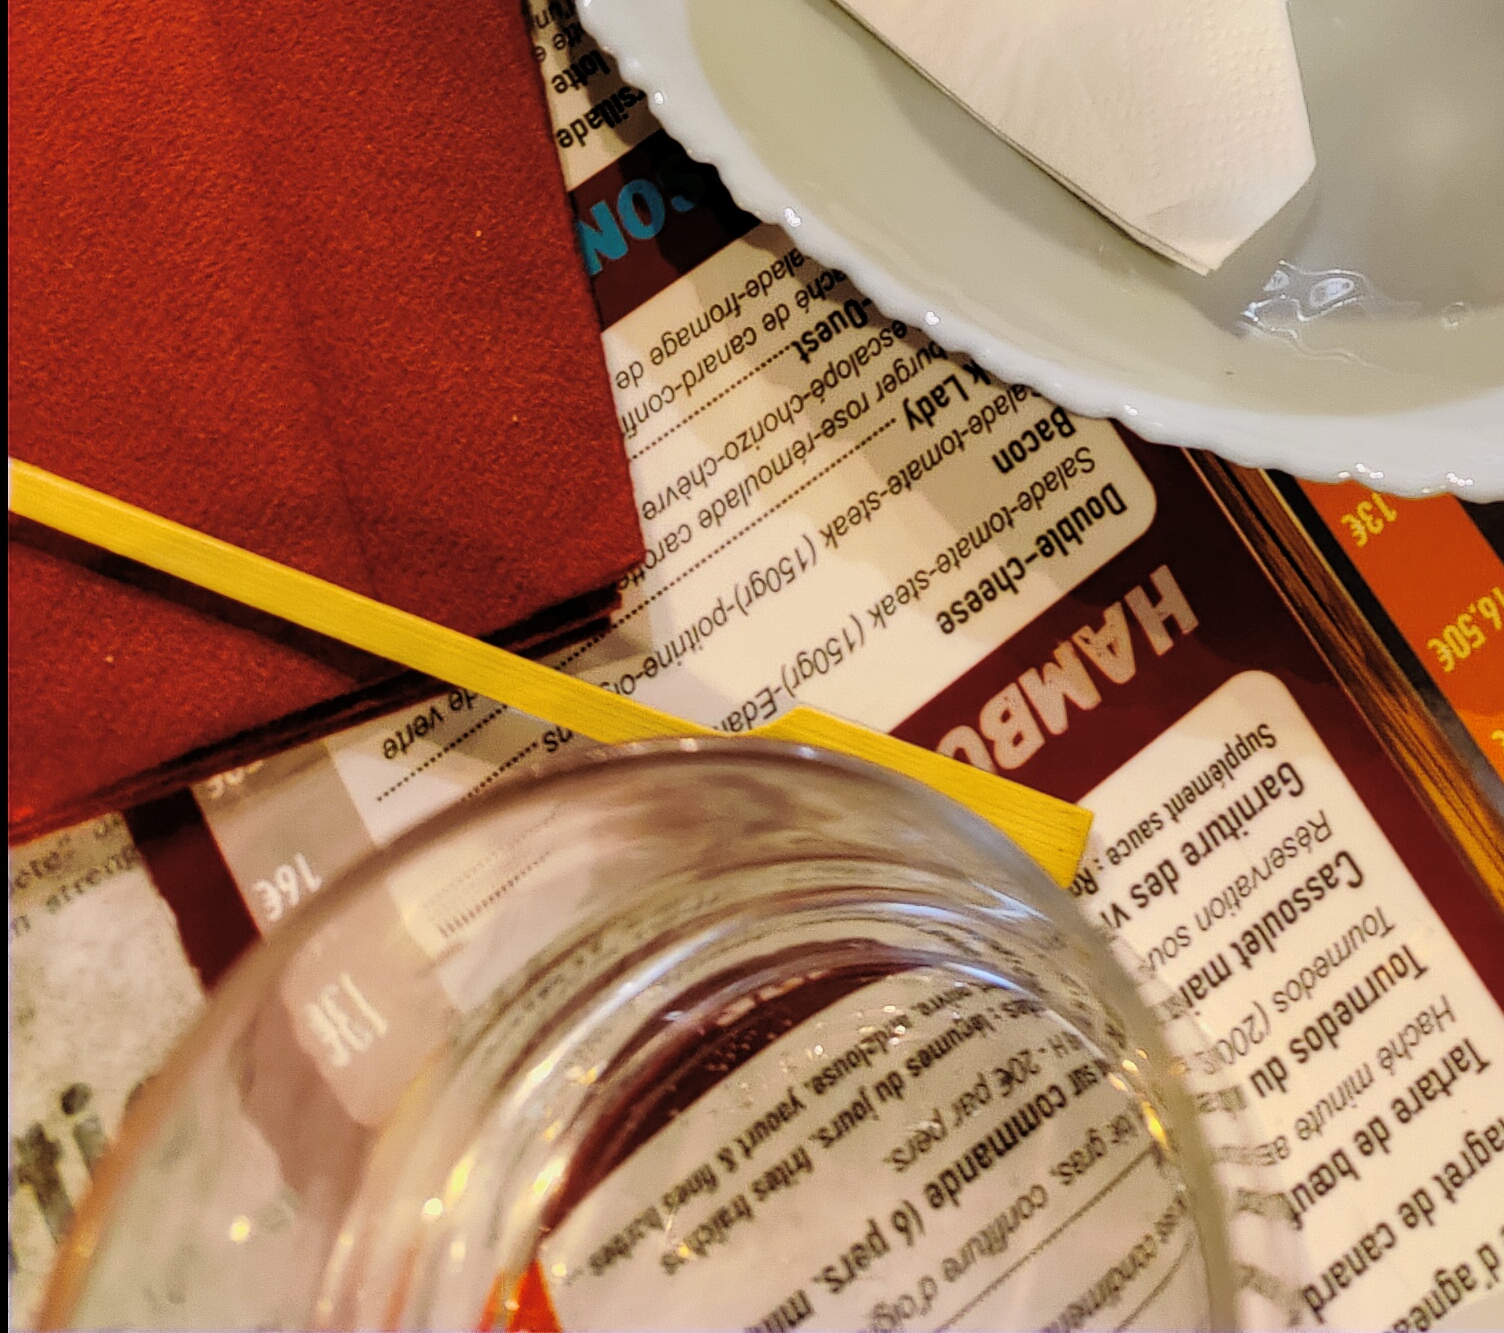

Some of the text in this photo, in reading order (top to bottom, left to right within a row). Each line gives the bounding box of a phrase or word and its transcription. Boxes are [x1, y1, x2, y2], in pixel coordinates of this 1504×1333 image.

[551, 77, 651, 159] rsillade
[609, 242, 808, 393] alade-fromage de
[611, 261, 850, 443] aché de canard-confi
[786, 286, 880, 370] -Ouest
[902, 372, 969, 432] Lady
[992, 404, 1076, 476] Bacon
[700, 392, 870, 528] rose-rémoulade
[874, 447, 1095, 621] Salade-tomate-steak
[938, 484, 1126, 633] Double-cheese
[1341, 486, 1397, 546] 13€
[938, 562, 1199, 773] HAMBU
[383, 705, 445, 759] verte
[1106, 724, 1277, 866] Supplément sauce
[1182, 762, 1304, 866] Garniture
[254, 854, 321, 920] 16€
[1130, 859, 1181, 913] des
[1196, 811, 1332, 931] Réservation
[1231, 851, 1363, 968] Cassoulet
[1272, 907, 1395, 1013] Tournedos
[1249, 946, 1426, 1102] Tournedos du
[1378, 996, 1456, 1075] Haché
[870, 1067, 914, 1114] du
[939, 1071, 998, 1128] par
[1295, 1064, 1374, 1141] minute
[1392, 1039, 1489, 1124] Tartare
[915, 1078, 1079, 1220] commande
[1354, 1116, 1393, 1163] de
[1398, 1188, 1438, 1235] de
[803, 1216, 896, 1304] pers.
[1298, 1223, 1398, 1324] canard
